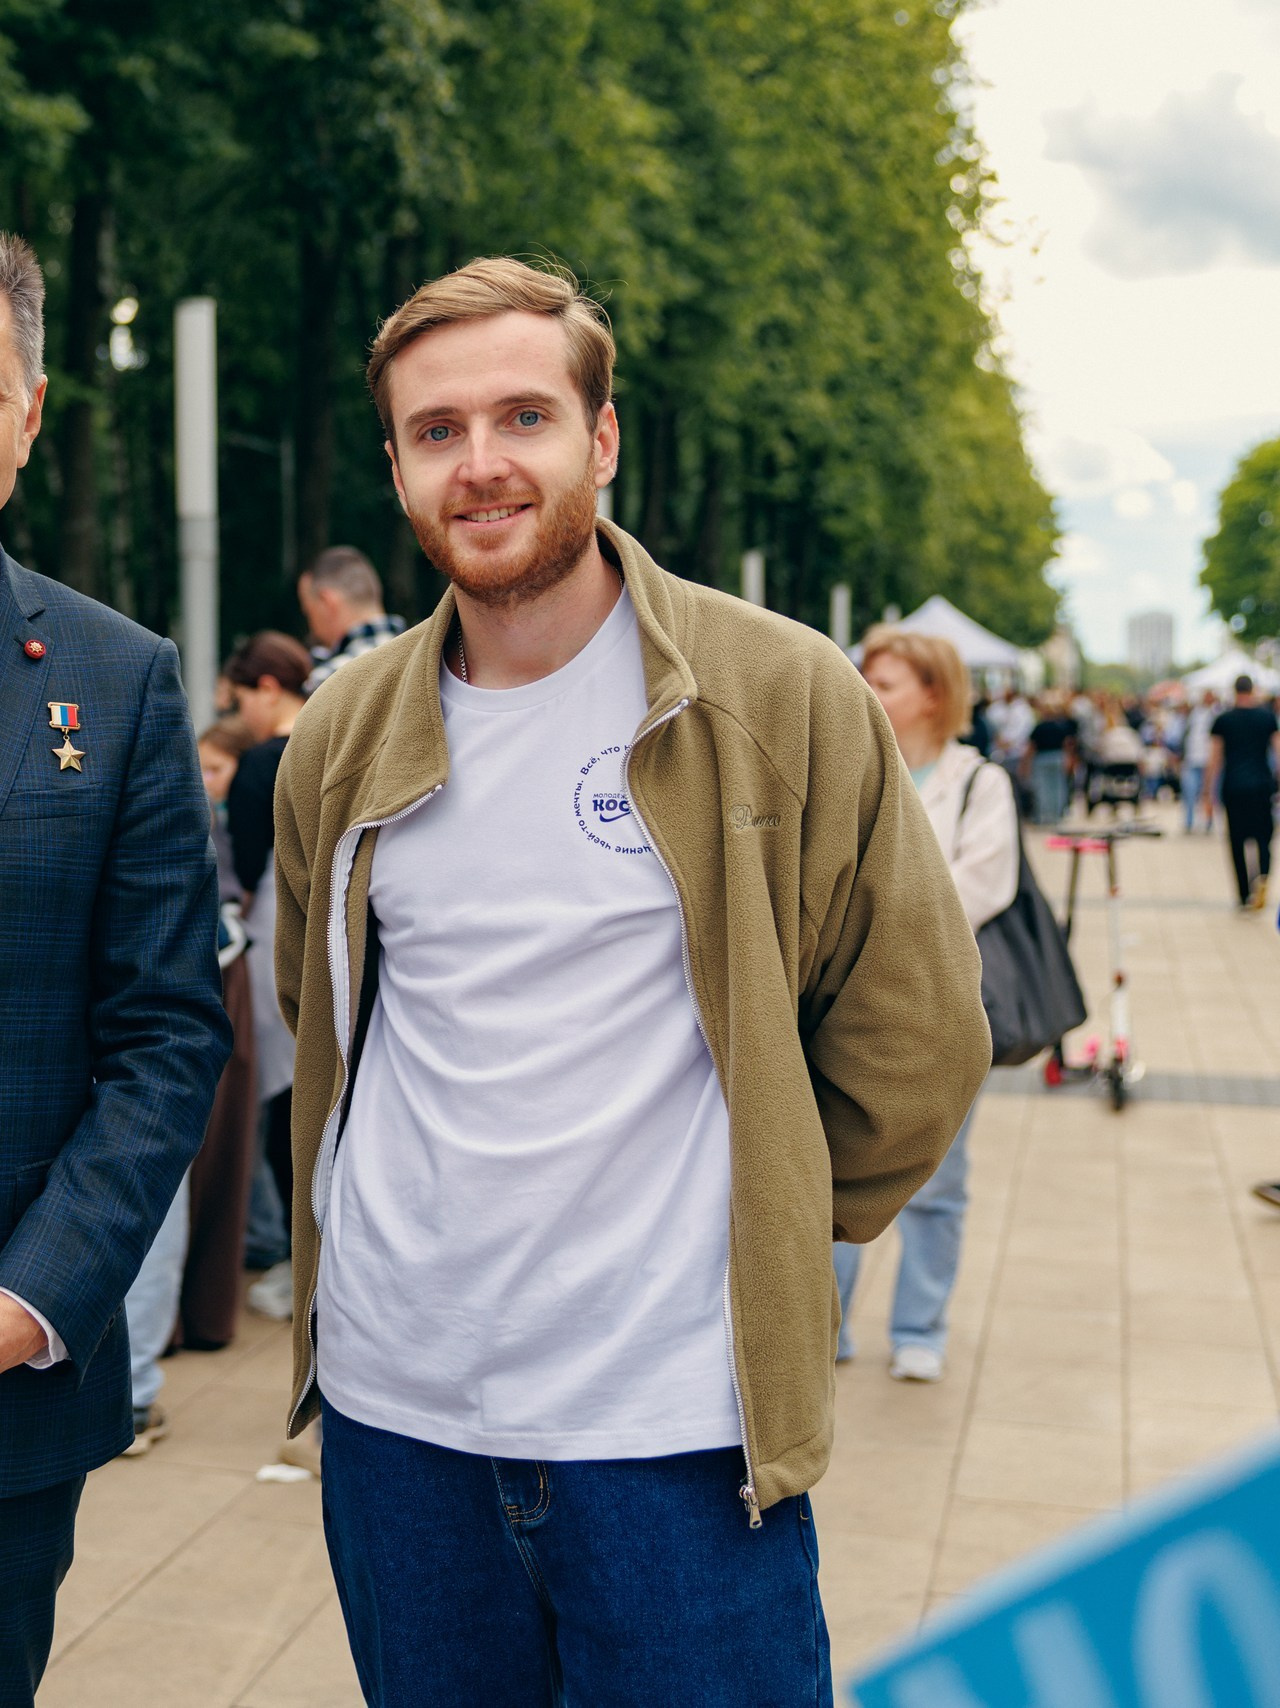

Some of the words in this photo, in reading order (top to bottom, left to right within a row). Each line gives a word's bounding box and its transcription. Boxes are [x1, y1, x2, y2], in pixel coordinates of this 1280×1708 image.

[601, 746, 620, 756] что
[580, 757, 600, 775] Всё,
[573, 780, 584, 817] мечты.
[578, 819, 611, 850] чьей-то
